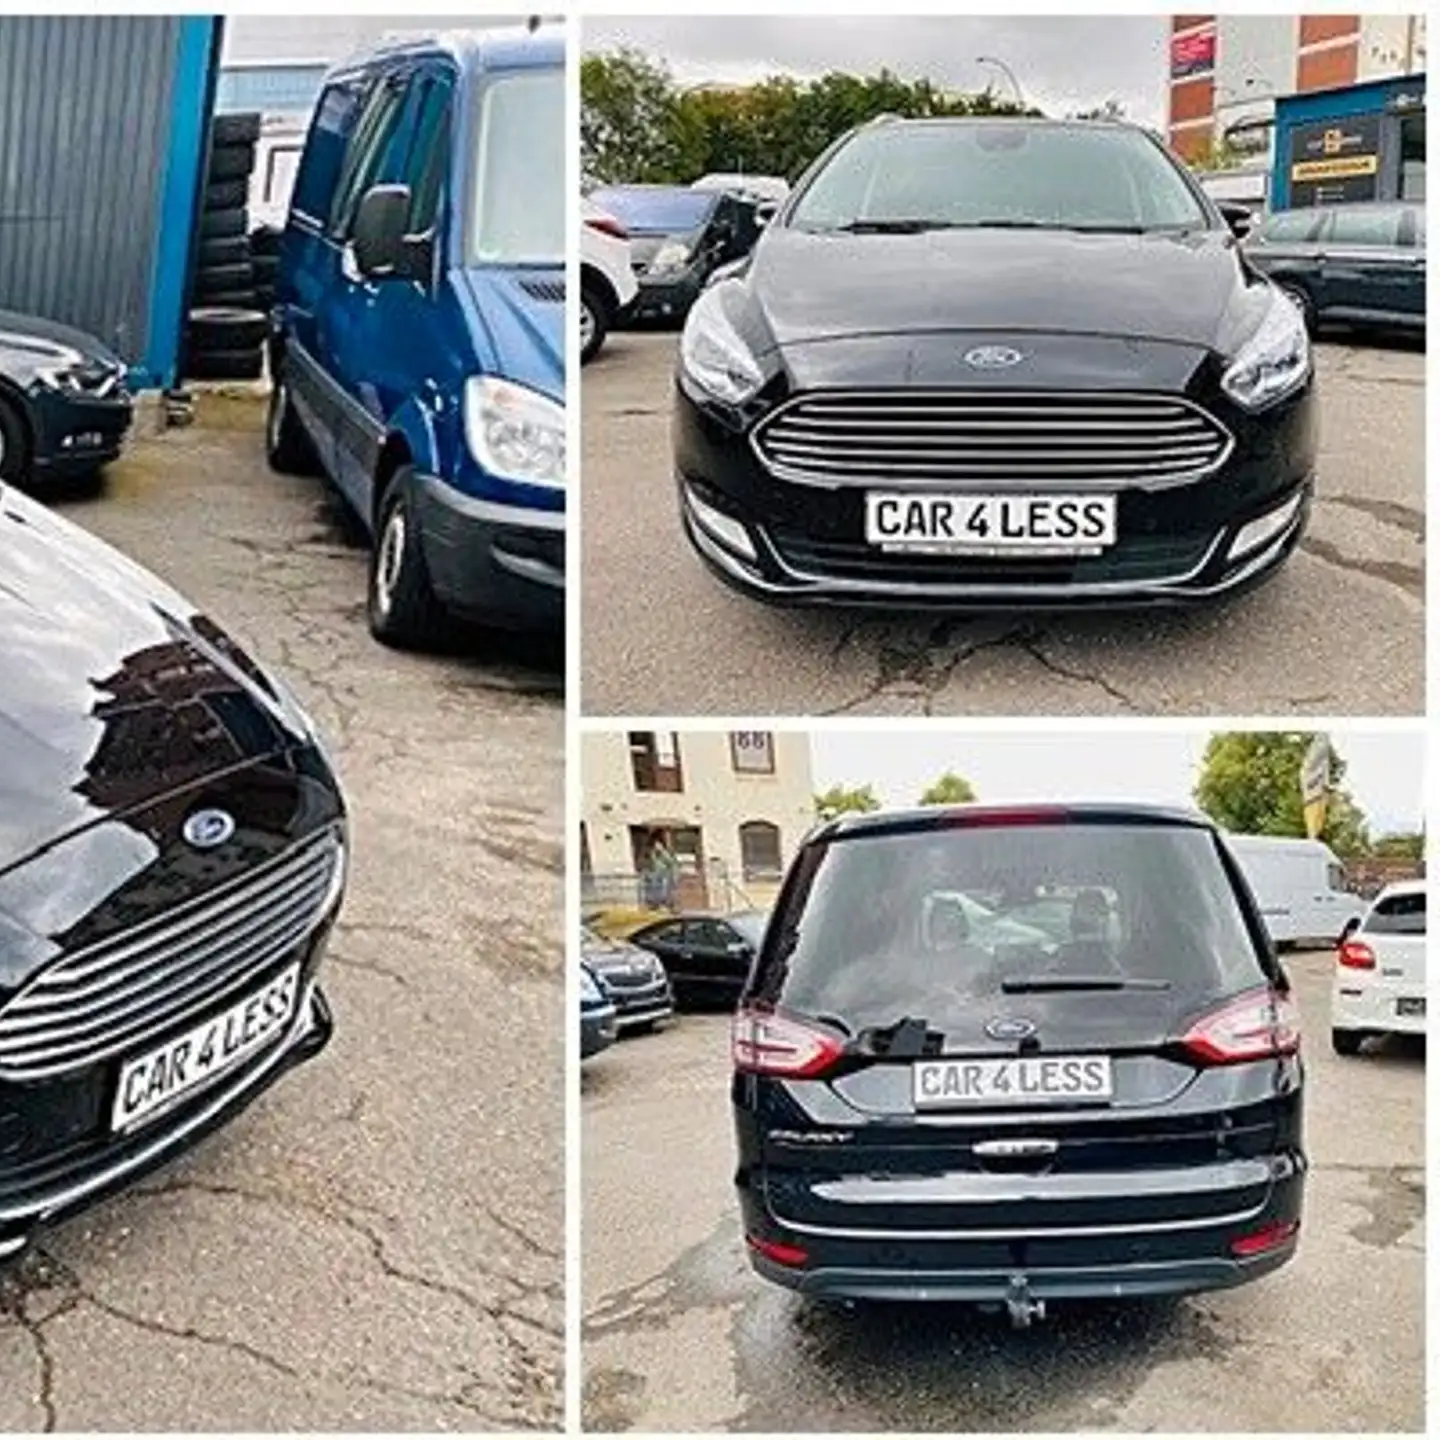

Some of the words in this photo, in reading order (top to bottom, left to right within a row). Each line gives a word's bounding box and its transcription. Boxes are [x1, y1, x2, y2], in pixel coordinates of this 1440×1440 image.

[876, 500, 955, 537] CAR
[966, 502, 990, 538] 4
[1001, 501, 1107, 538] LESS
[123, 1040, 192, 1114] CAR
[196, 1025, 217, 1068] 4
[223, 973, 294, 1056] LESS
[920, 1065, 984, 1096] CAR
[993, 1065, 1010, 1093] 4
[1018, 1061, 1104, 1093] LESS
